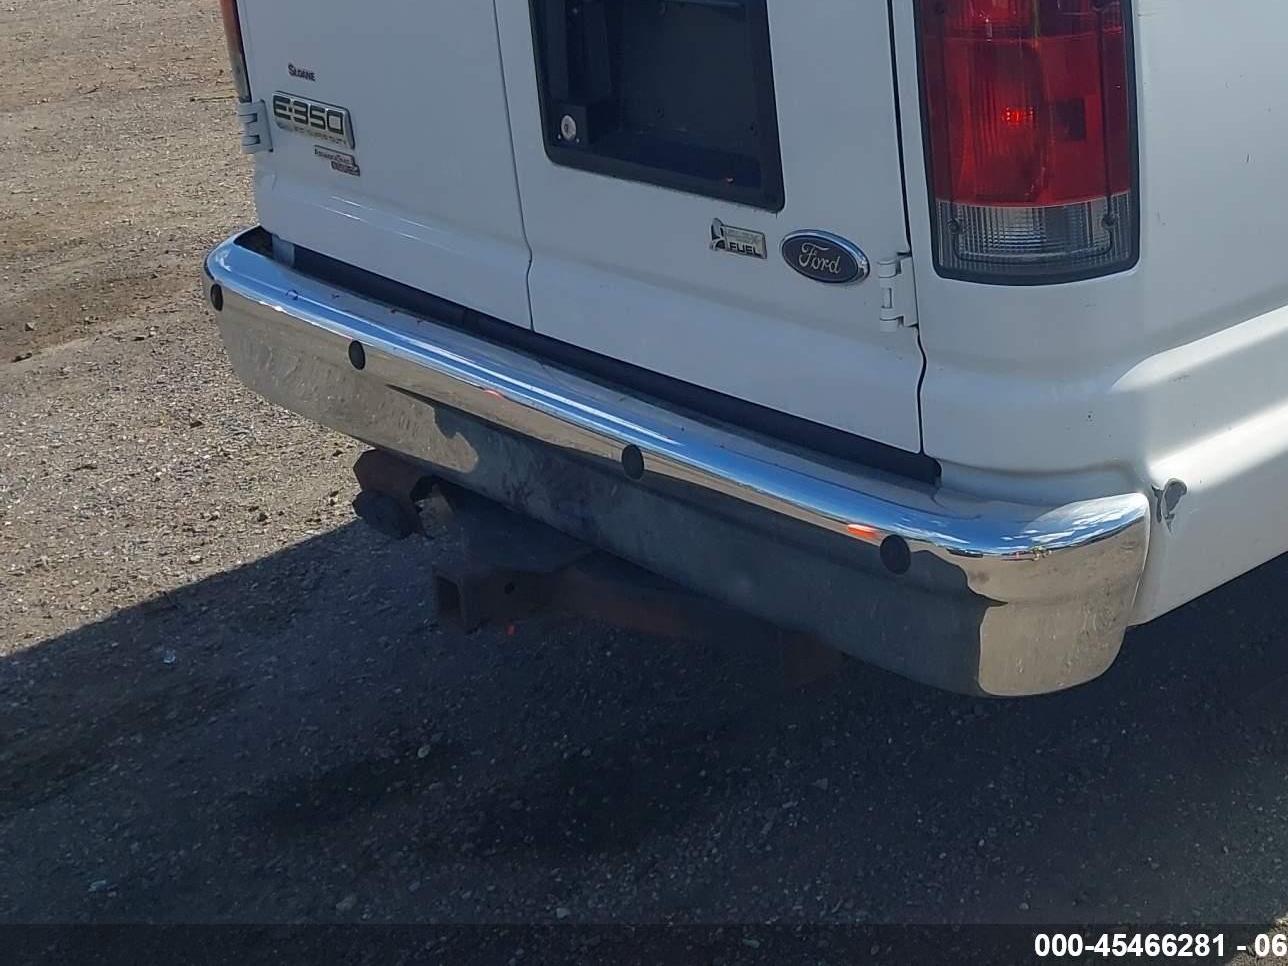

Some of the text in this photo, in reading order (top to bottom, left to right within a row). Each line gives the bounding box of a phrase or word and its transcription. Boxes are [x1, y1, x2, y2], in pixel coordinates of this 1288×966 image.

[273, 94, 345, 136] E-350
[729, 241, 763, 259] FUEL
[798, 242, 842, 275] Ford
